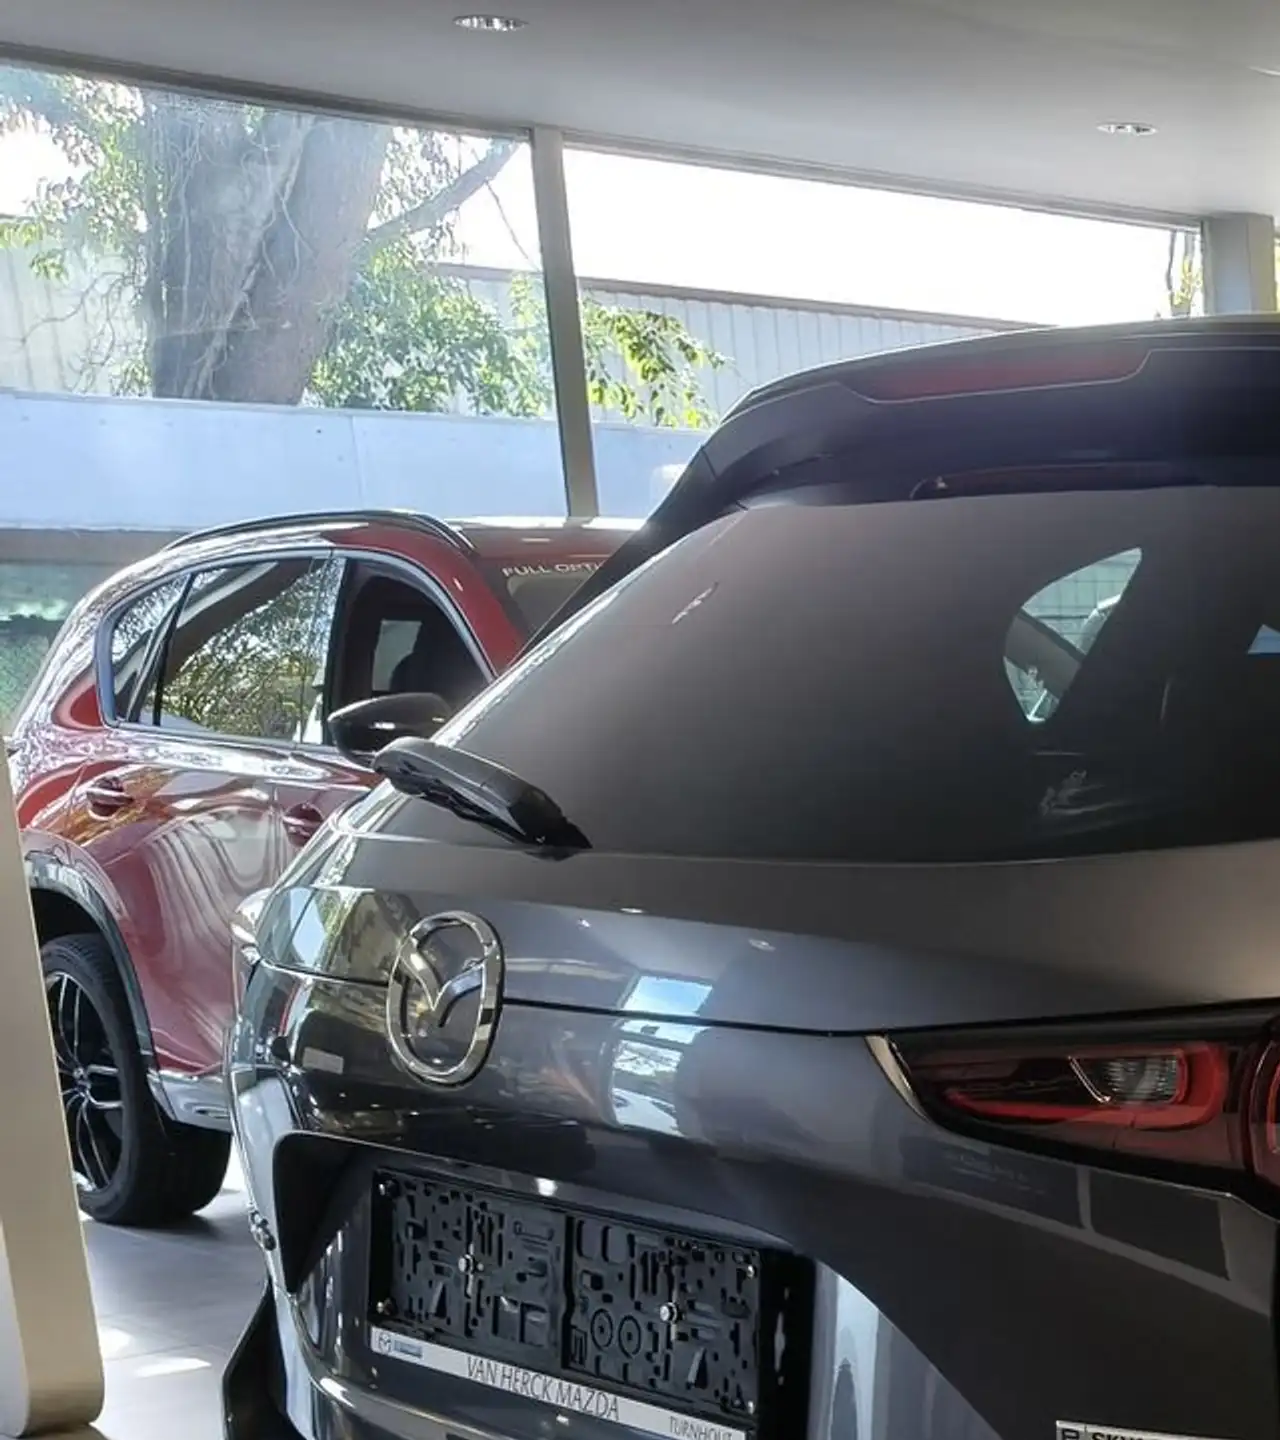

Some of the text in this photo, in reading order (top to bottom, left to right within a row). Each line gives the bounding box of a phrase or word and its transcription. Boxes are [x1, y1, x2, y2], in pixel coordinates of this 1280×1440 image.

[502, 564, 552, 577] FULL
[466, 1356, 621, 1422] VAN HERCK MAZDA
